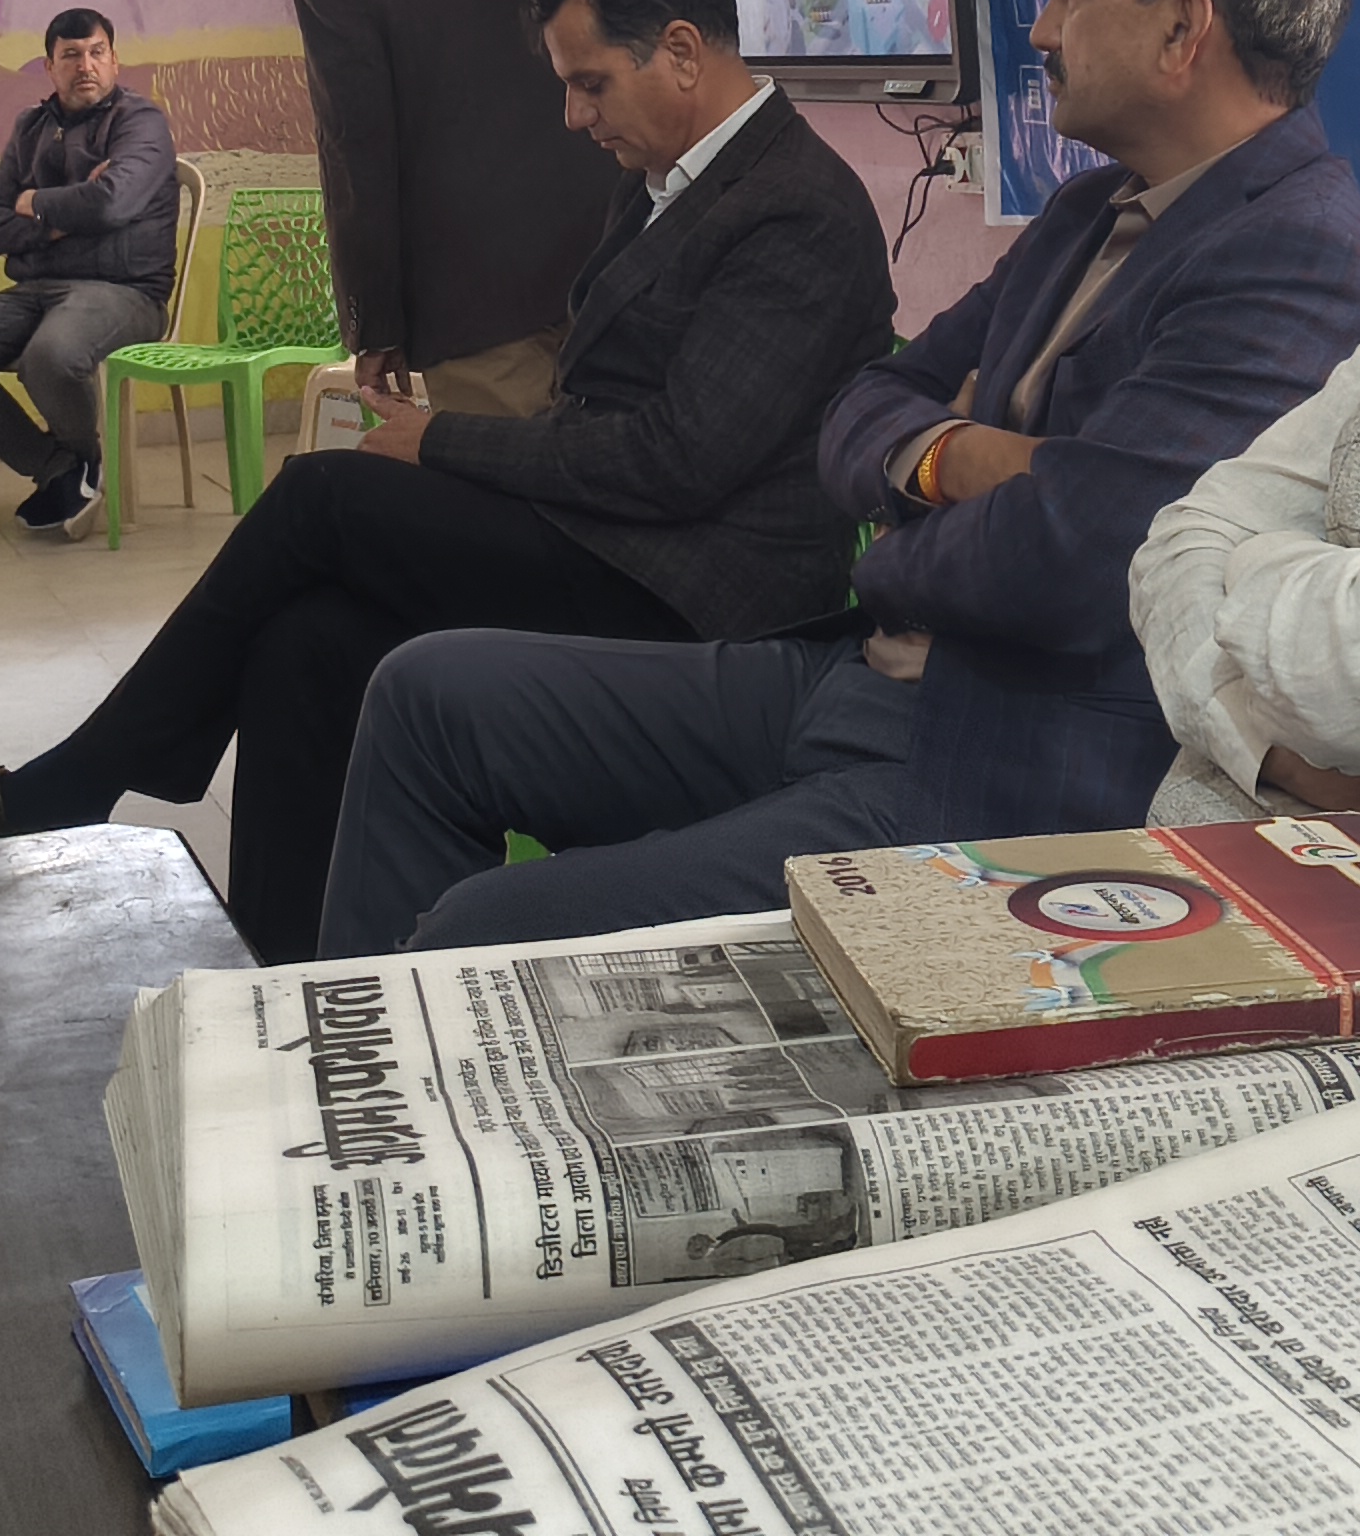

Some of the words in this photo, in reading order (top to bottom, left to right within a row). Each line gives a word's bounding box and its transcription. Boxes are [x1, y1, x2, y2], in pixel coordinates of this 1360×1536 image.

[819, 857, 876, 896] 2016
[277, 976, 399, 1105] उपभोक्ता
[477, 1039, 500, 1047] है
[484, 1046, 508, 1062] हुआ
[509, 1039, 533, 1055] जाने
[518, 1056, 538, 1079] बनाए
[557, 1147, 582, 1161] एवं
[530, 1160, 553, 1199] माध्यम
[563, 1161, 591, 1202] आयोग
[1305, 1173, 1358, 1216] जमानती
[360, 1198, 378, 1228] जनवरी
[1133, 1214, 1172, 1242] नहीं
[313, 1219, 332, 1249] जिला
[367, 1231, 380, 1246] 10
[535, 1204, 563, 1280] डिजीटल
[570, 1209, 597, 1258] जिला
[314, 1251, 334, 1306] संगरिया,
[365, 1249, 382, 1301] शनिवार,
[1270, 1329, 1305, 1361] तो
[575, 1339, 675, 1412] उत्तरदायी
[1297, 1355, 1350, 1394] खरीदा
[703, 1375, 752, 1414] निर्णय
[633, 1412, 727, 1493] कम्पनी
[750, 1443, 787, 1474] कर
[619, 1476, 679, 1525] निर्णय
